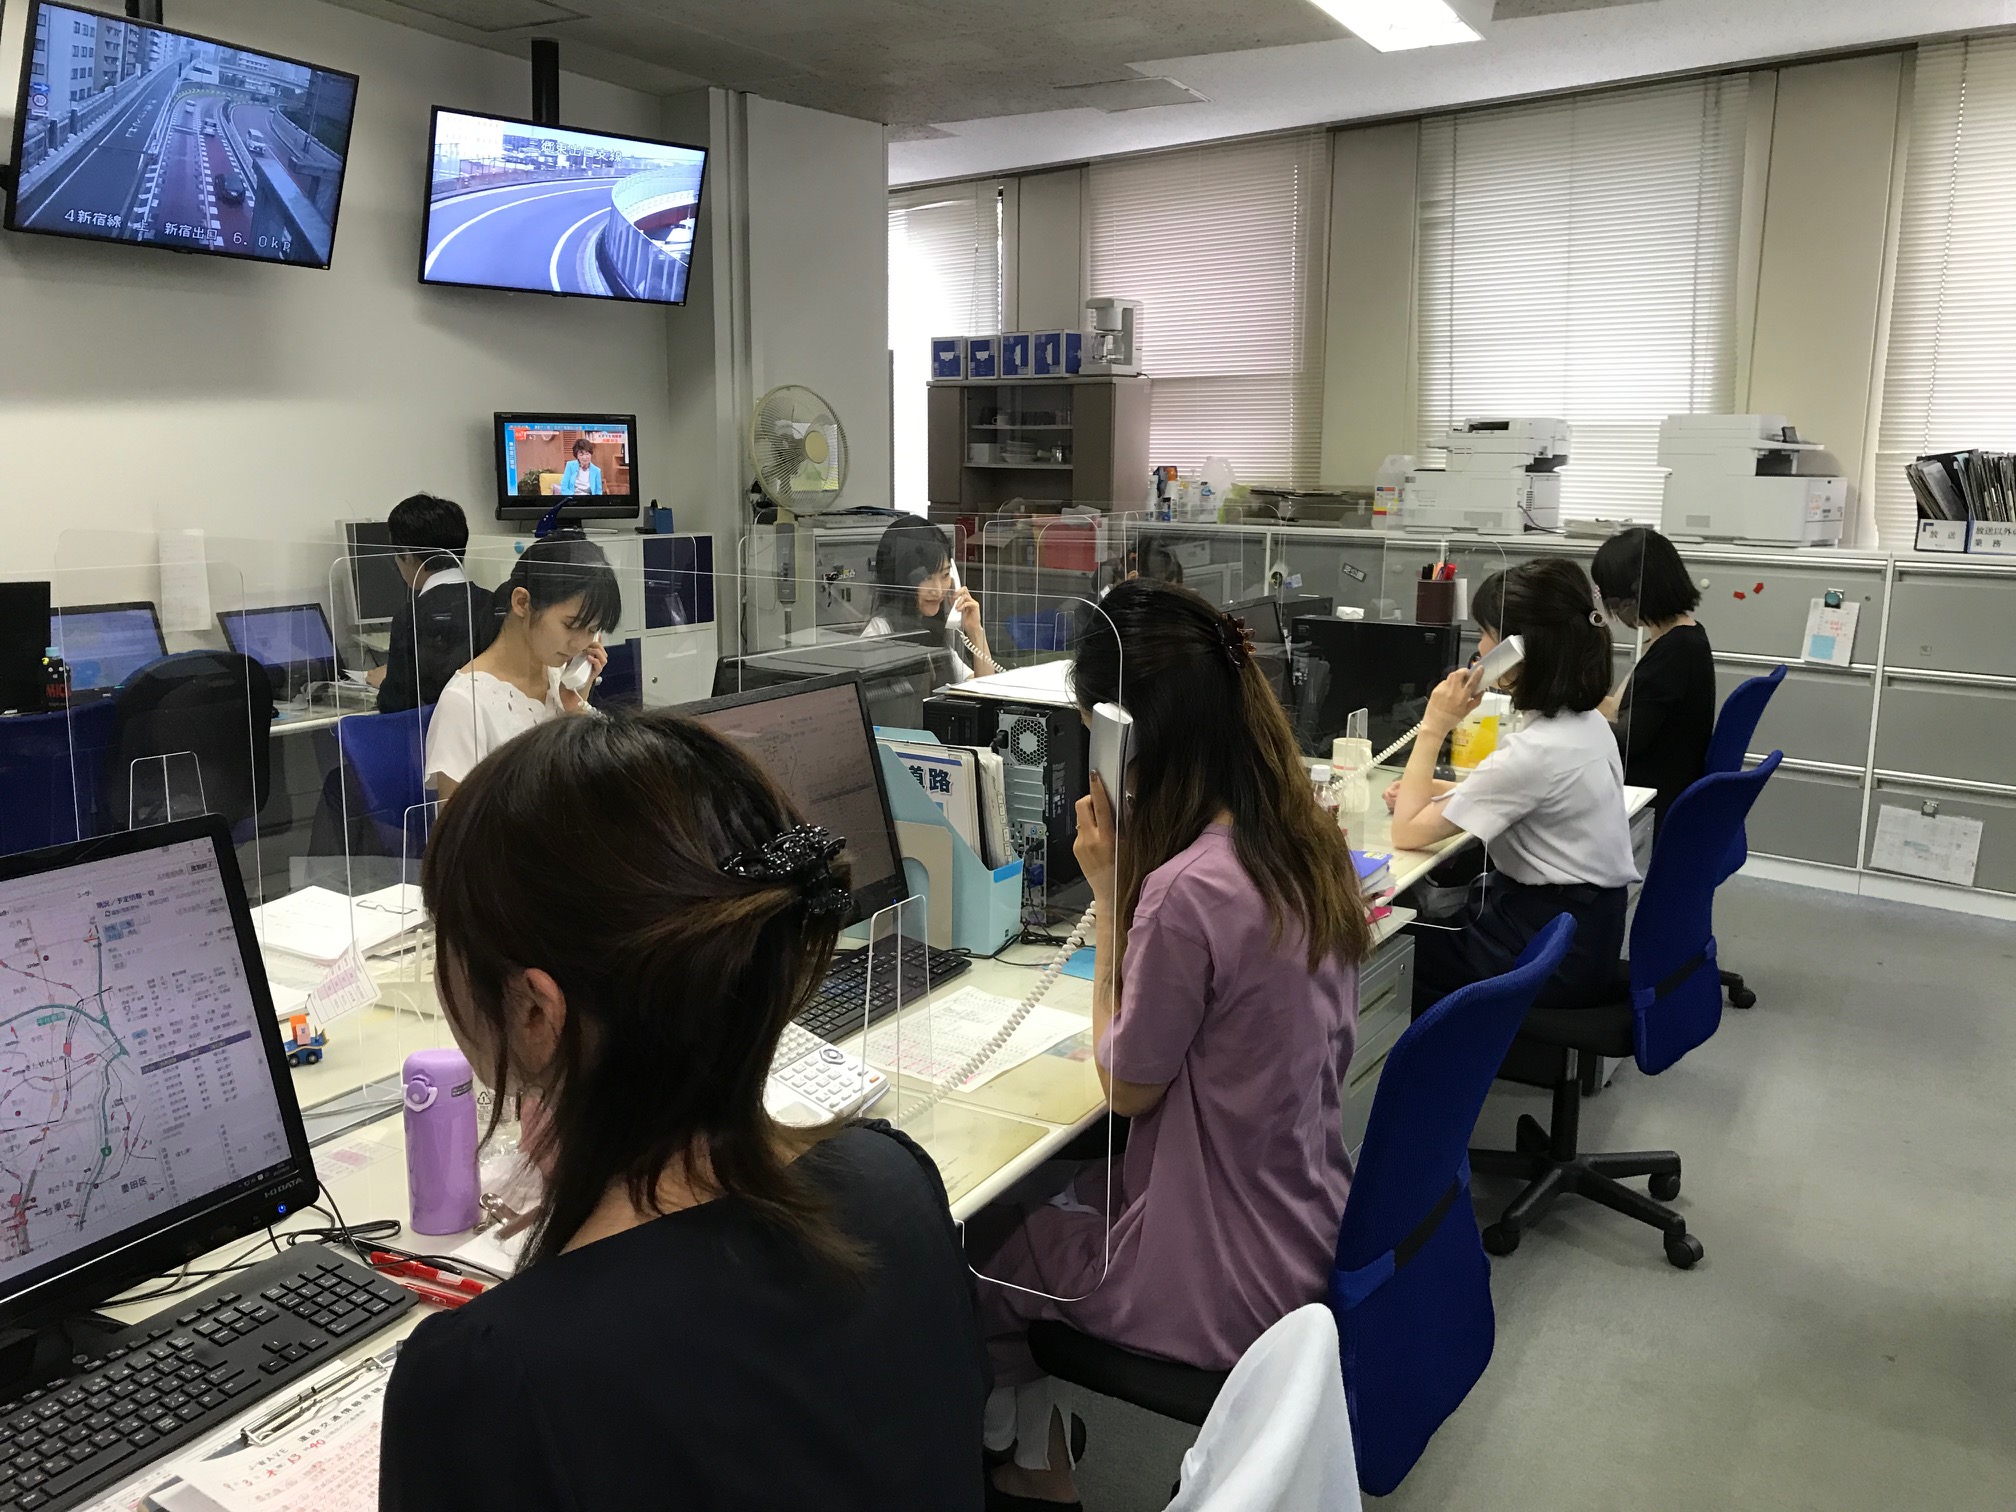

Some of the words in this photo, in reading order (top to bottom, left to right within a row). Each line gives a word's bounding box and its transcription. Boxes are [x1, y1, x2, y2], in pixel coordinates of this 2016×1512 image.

[64, 209, 122, 228] 4新宿線
[164, 222, 218, 241] 新宿出口
